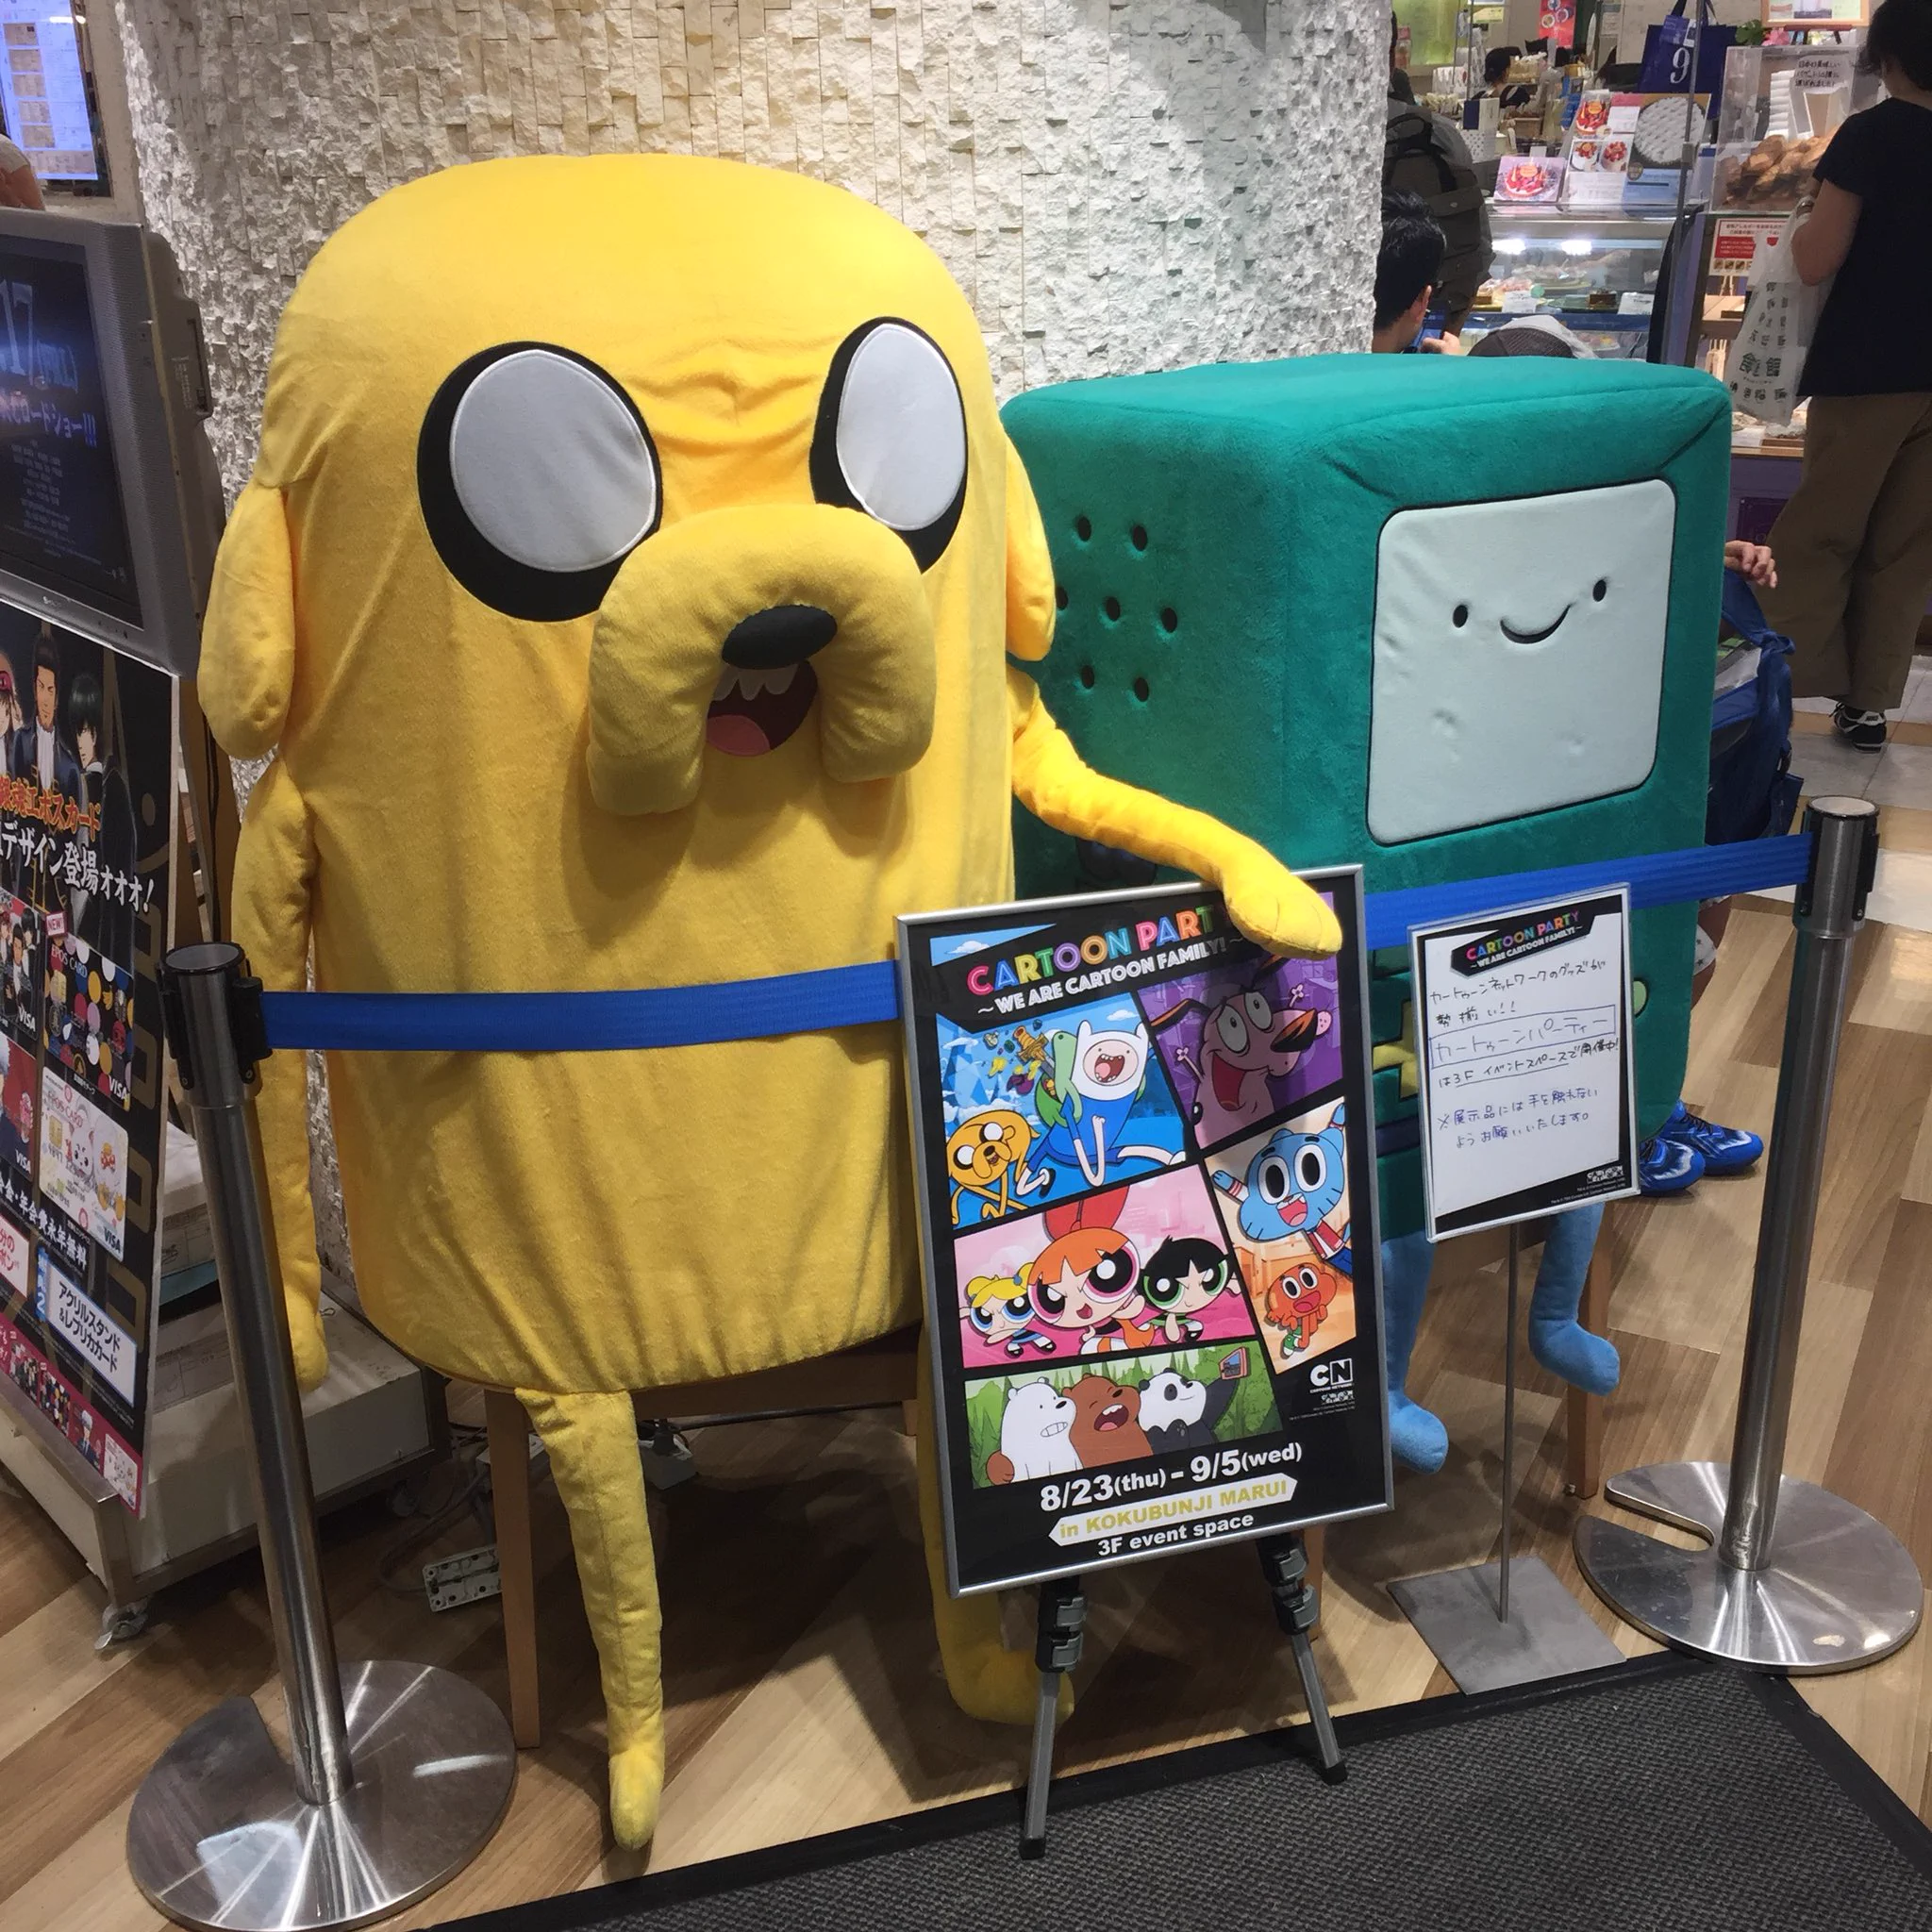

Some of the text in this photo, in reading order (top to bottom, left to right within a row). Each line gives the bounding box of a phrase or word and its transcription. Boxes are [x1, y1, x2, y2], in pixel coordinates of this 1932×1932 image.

[1670, 47, 1690, 84] 9
[967, 905, 1224, 995] CARTOON PART
[1466, 910, 1579, 960] CARTOON PARTY
[1491, 952, 1507, 963] ARE
[1507, 939, 1545, 957] CARTOON
[51, 944, 88, 978] EPOS CARD
[1028, 984, 1063, 1006] ARE
[1065, 956, 1156, 994] CARTOON
[18, 1005, 36, 1032] VISA
[108, 1074, 127, 1101] VISA
[65, 1103, 83, 1128] CARD
[15, 1149, 32, 1174] VISA
[104, 1227, 121, 1254] VISA
[58, 1280, 121, 1353] アクリルスタンド
[1310, 1358, 1353, 1387] CN
[1041, 1469, 1166, 1511] 8/23(thu)
[1191, 1442, 1303, 1482] 9/5(wed)
[1060, 1479, 1287, 1540] in KOKUBUNJI MARUI
[1098, 1514, 1255, 1556] 3F event space
